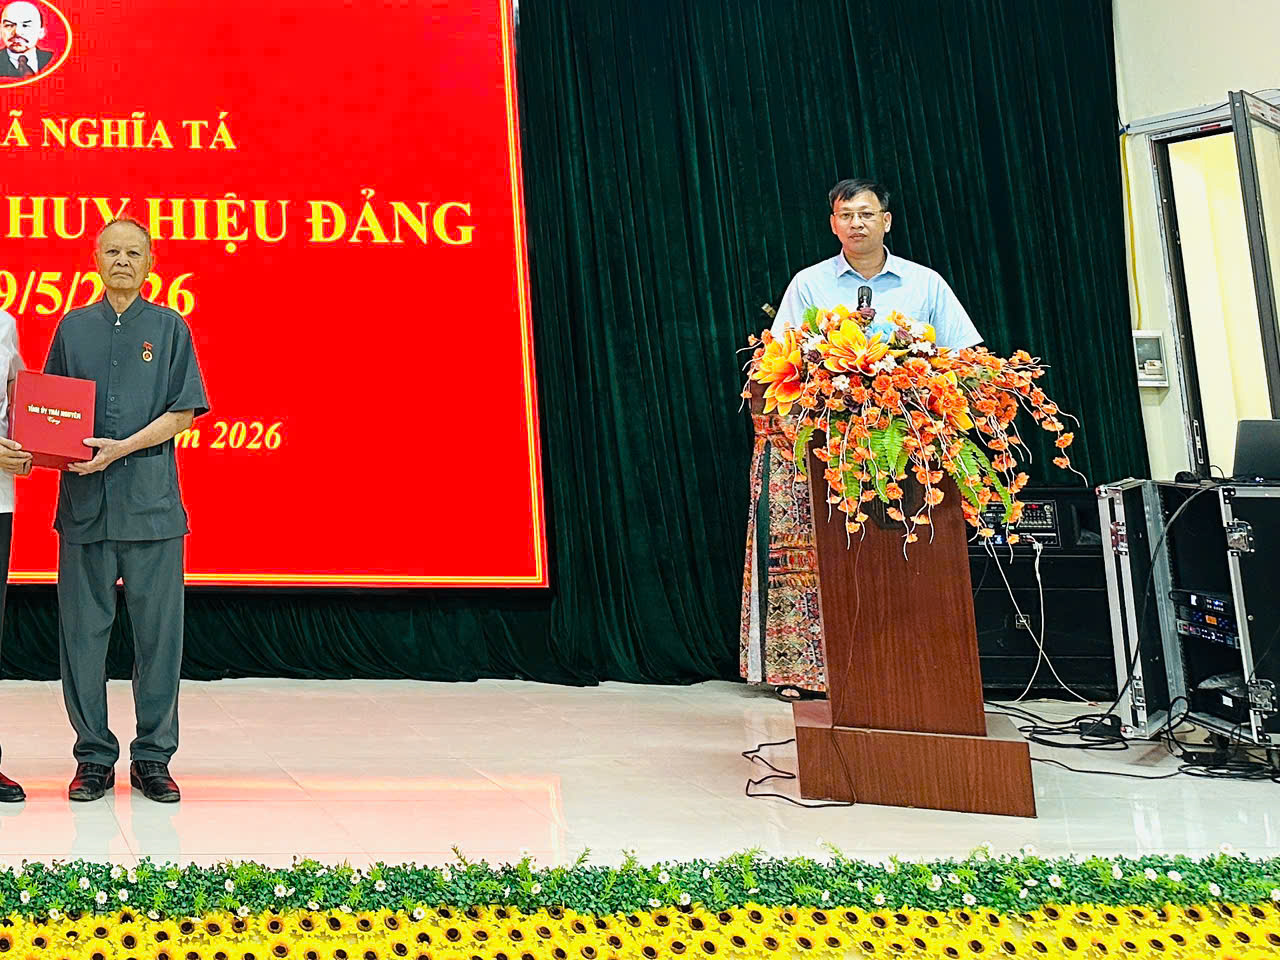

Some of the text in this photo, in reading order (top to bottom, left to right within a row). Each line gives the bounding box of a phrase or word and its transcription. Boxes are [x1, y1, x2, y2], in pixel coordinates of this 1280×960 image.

[41, 112, 174, 149] NGHĨA
[182, 112, 238, 150] TÁ
[5, 196, 131, 240] HUY
[142, 192, 289, 253] HIỆU
[305, 187, 476, 245] ĐẢNG
[209, 421, 283, 449] 2026
